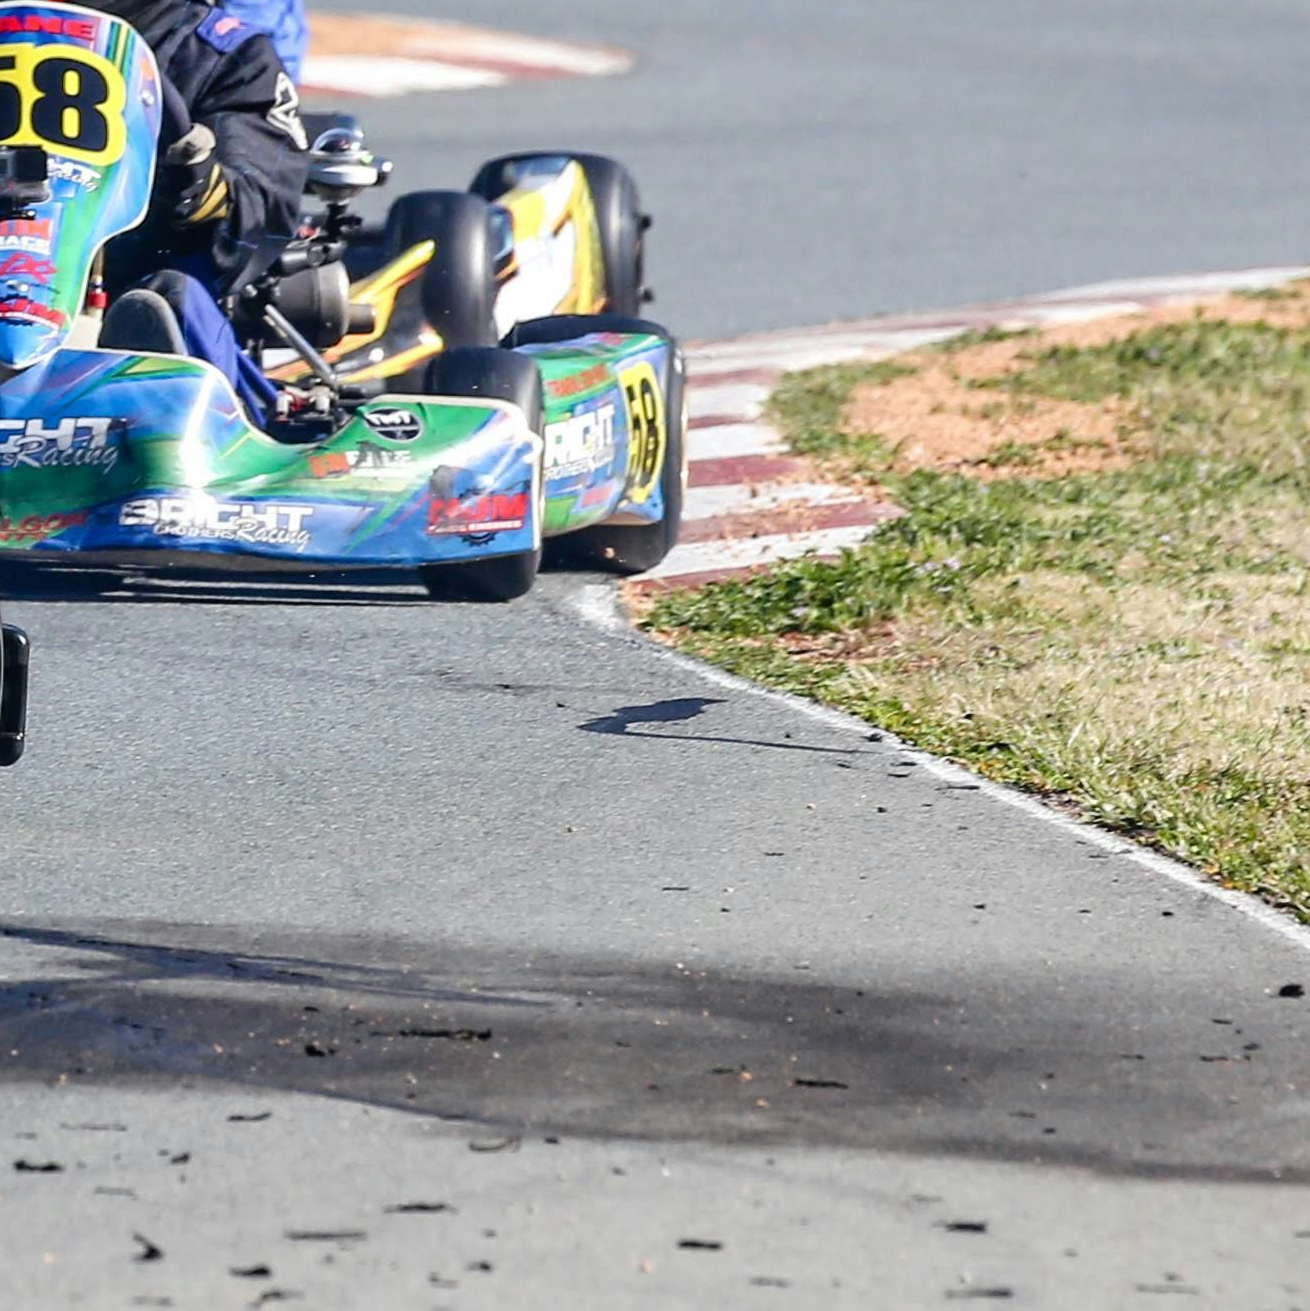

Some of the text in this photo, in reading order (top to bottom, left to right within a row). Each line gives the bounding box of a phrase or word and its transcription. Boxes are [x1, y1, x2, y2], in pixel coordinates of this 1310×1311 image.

[626, 378, 660, 489] 58
[11, 434, 120, 474] Racing
[118, 496, 314, 532] BRIGHT
[235, 517, 312, 552] Racing
